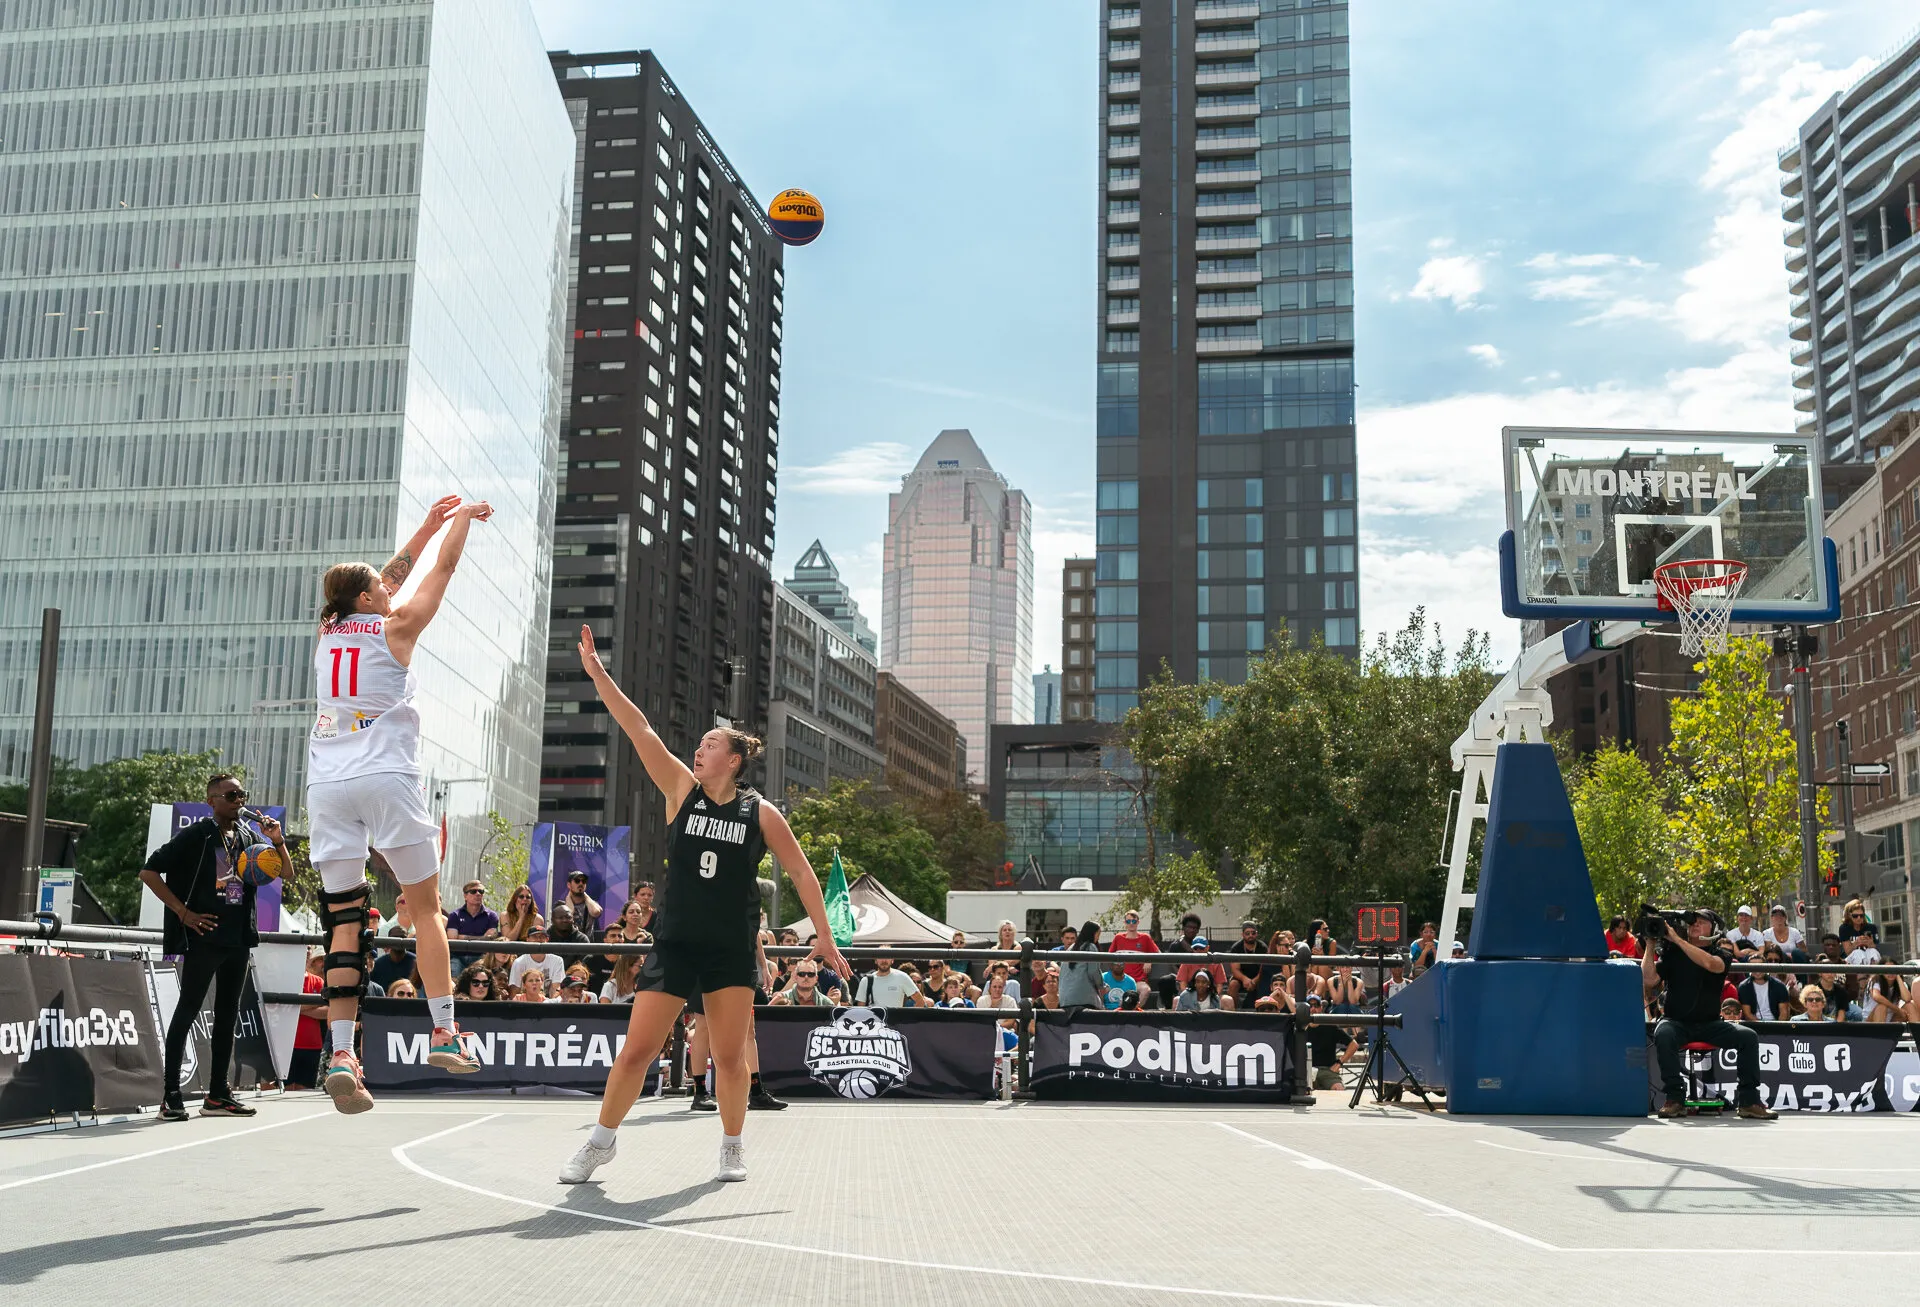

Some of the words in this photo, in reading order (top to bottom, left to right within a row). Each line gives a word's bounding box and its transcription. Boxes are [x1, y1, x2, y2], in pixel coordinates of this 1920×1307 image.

[778, 204, 817, 216] Wilson
[1557, 465, 1757, 500] MONTRÉAL
[1526, 596, 1557, 604] SPALDING
[330, 647, 360, 697] 11
[685, 813, 708, 837] NEW
[705, 817, 747, 845] ZEALAND
[558, 833, 604, 849] DISTRIX
[699, 850, 718, 879] 9
[387, 1024, 627, 1067] MNTRÉA
[1792, 1039, 1810, 1053] You
[827, 1058, 871, 1067] BASKETBALL
[873, 1060, 891, 1069] CLUB
[1069, 1030, 1276, 1086] Podium
[1790, 1056, 1814, 1070] Tube
[1069, 1070, 1223, 1086] productions
